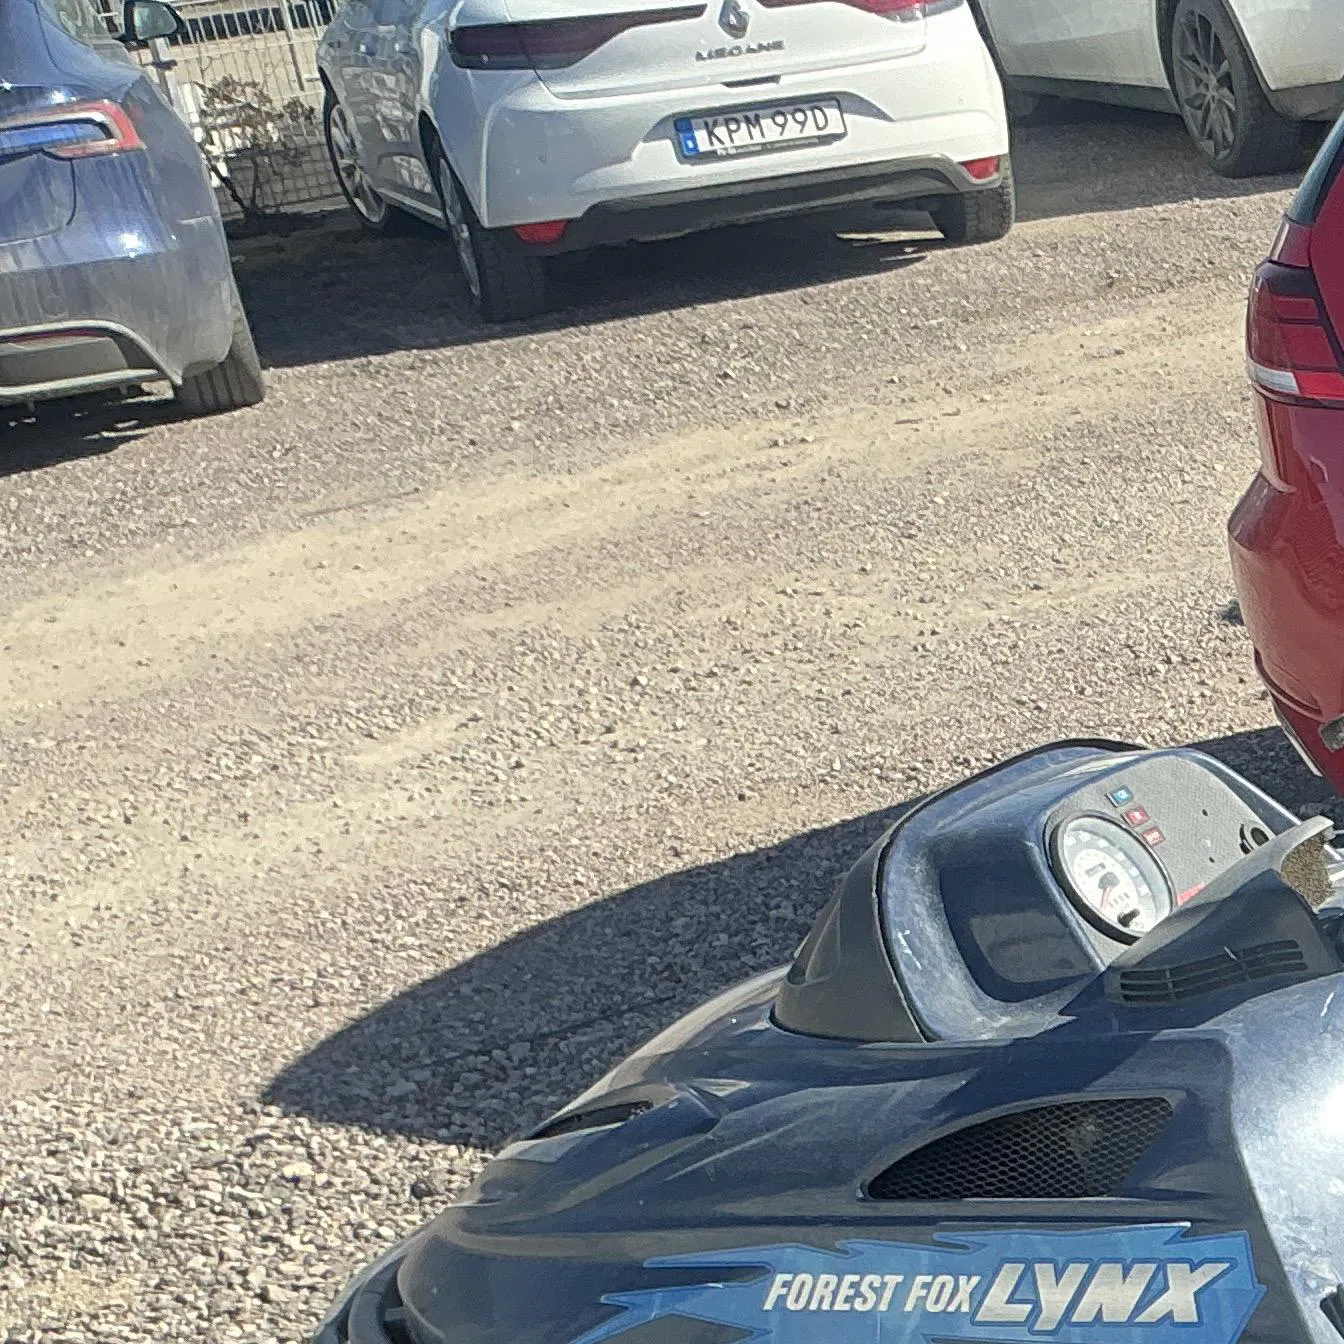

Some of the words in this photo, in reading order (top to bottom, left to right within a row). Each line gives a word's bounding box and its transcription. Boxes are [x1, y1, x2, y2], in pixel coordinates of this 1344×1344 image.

[703, 113, 765, 147] KPM
[770, 104, 829, 137] 99D
[762, 1272, 904, 1312] FOREST
[903, 1274, 982, 1313] FOX
[973, 1260, 1232, 1332] LYNX
